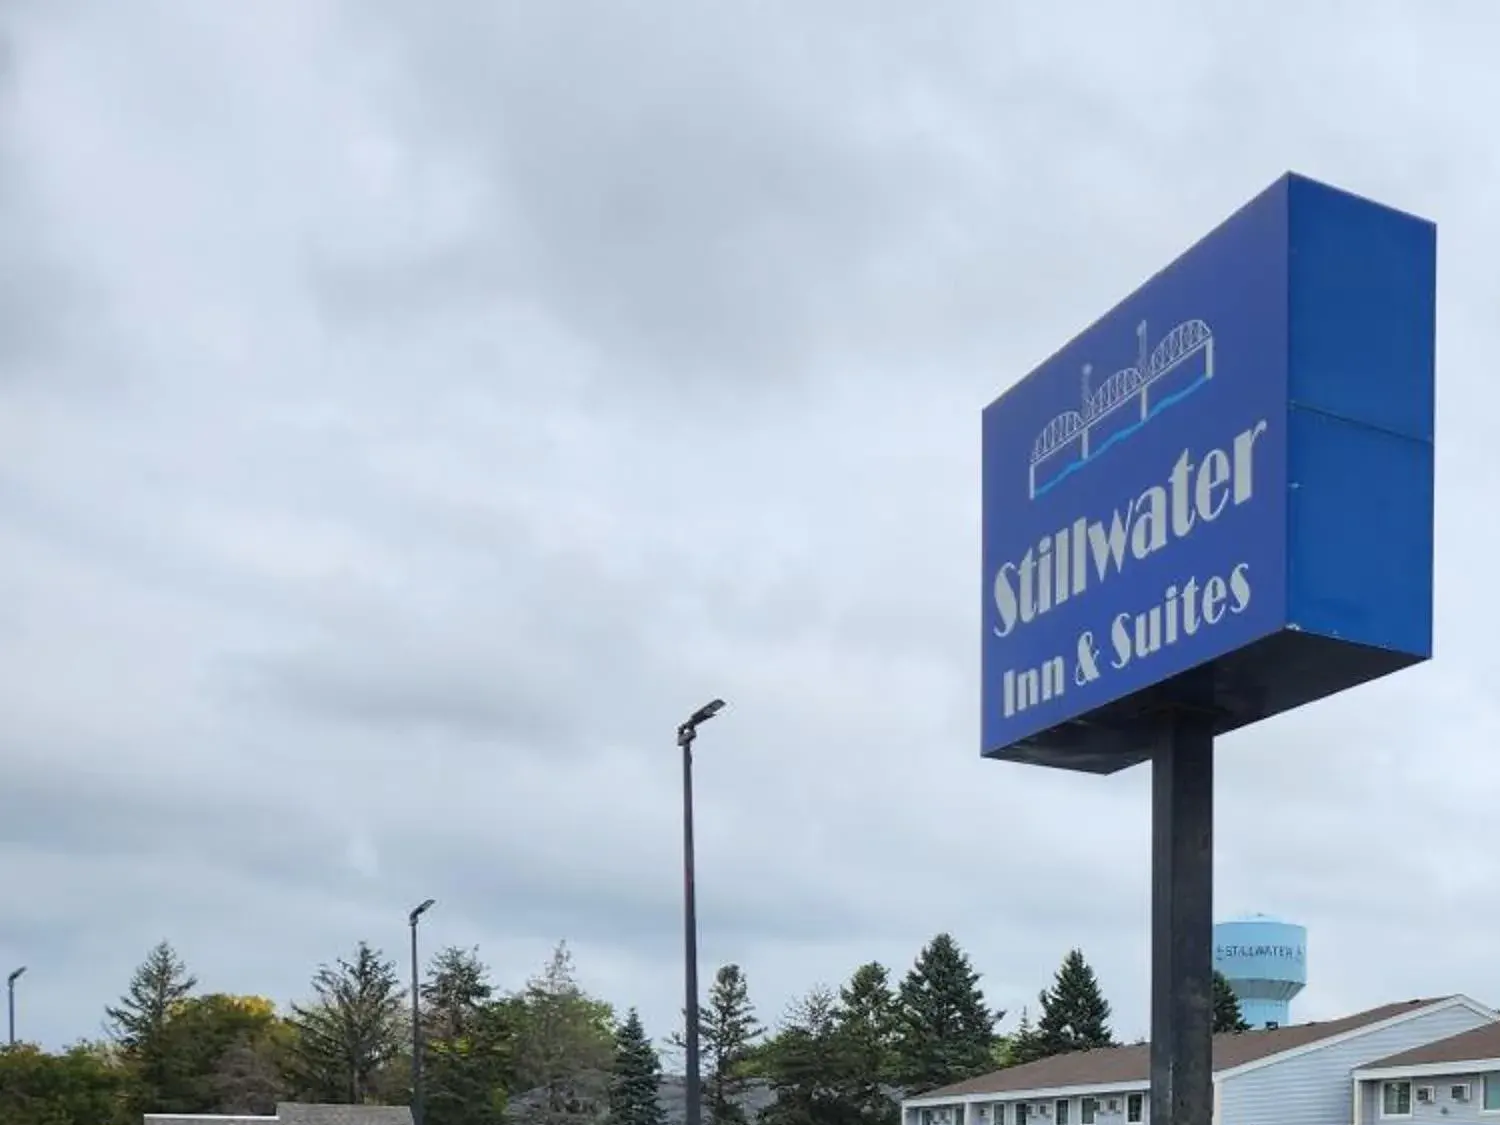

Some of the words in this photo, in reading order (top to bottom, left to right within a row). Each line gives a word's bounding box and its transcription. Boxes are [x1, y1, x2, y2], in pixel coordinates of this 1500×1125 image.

[993, 419, 1267, 637] Stillwater
[1003, 656, 1065, 718] Inn
[1074, 631, 1101, 686] &
[1110, 563, 1251, 669] Suites
[1225, 945, 1293, 958] STILLWATER
